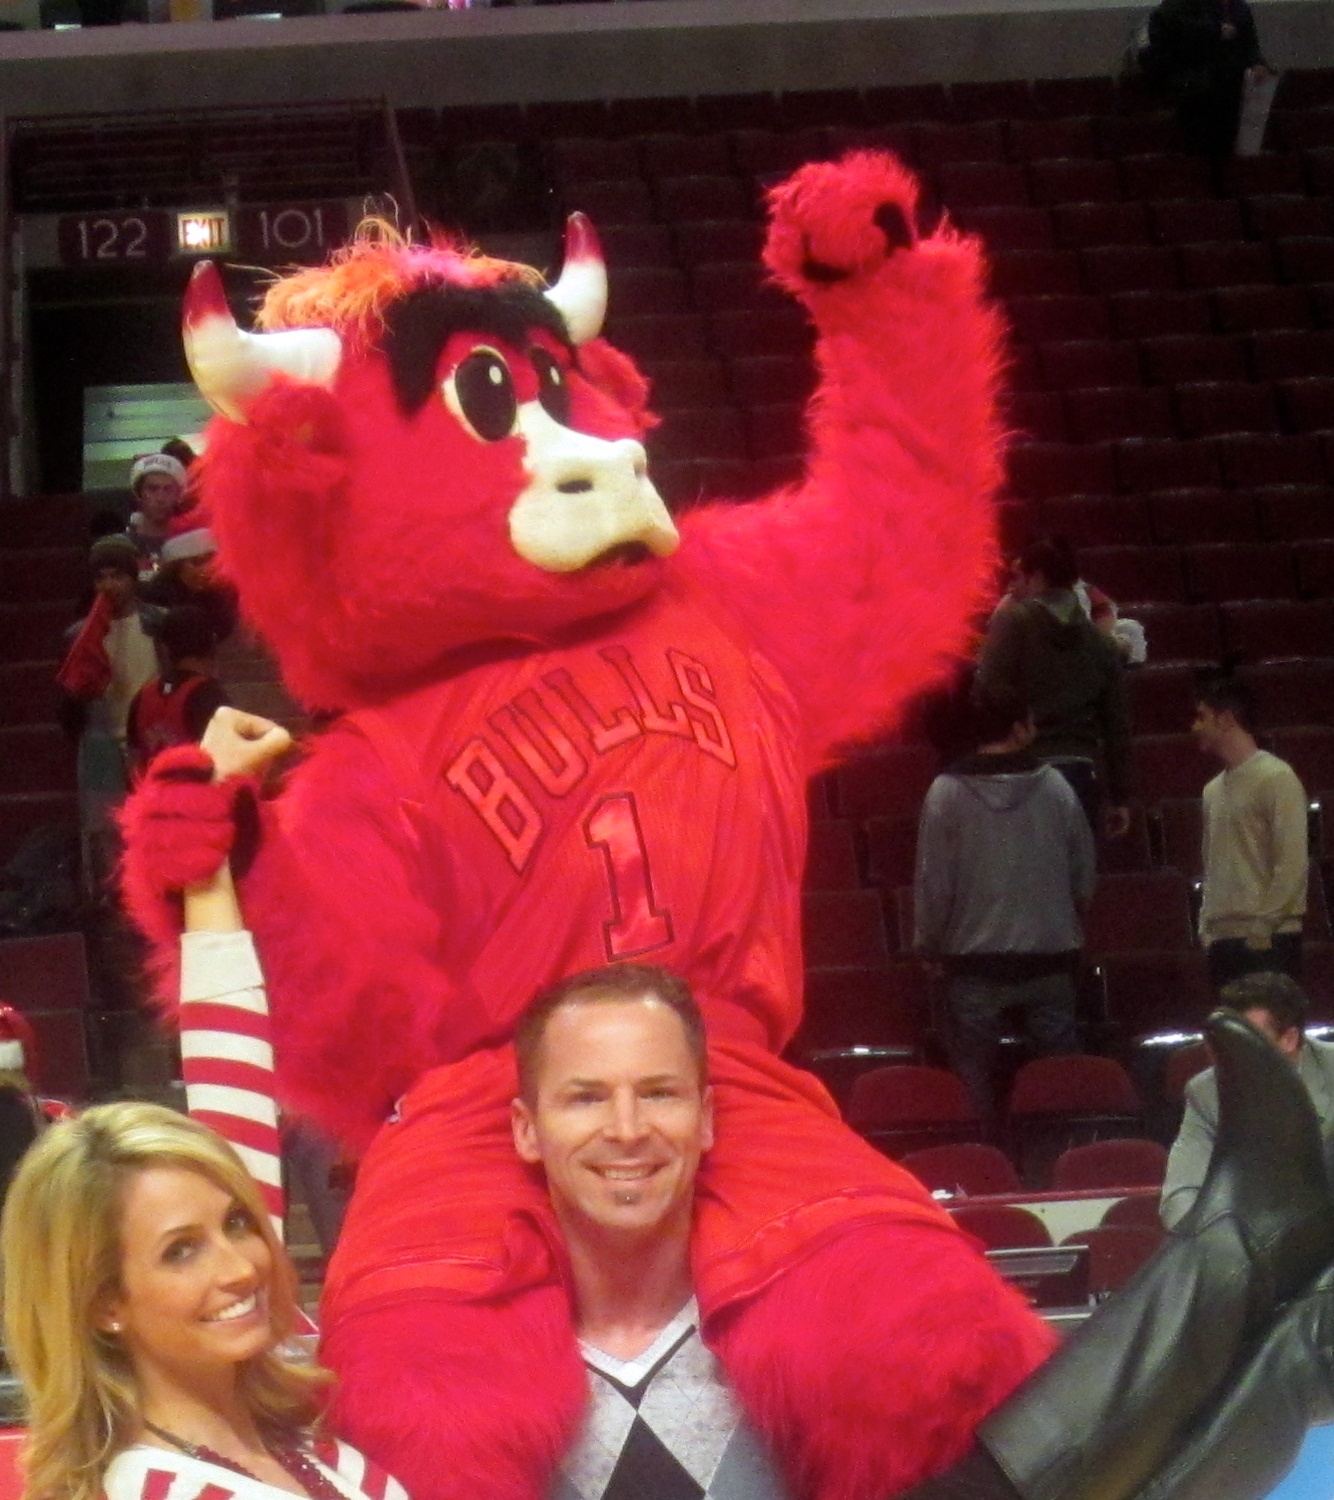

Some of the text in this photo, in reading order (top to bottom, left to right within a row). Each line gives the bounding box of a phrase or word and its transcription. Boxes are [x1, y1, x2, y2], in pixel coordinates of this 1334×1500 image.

[78, 217, 147, 259] 122
[181, 217, 225, 247] EXIT
[259, 208, 323, 249] 101
[443, 644, 737, 877] BULLS
[582, 791, 675, 960] 1
